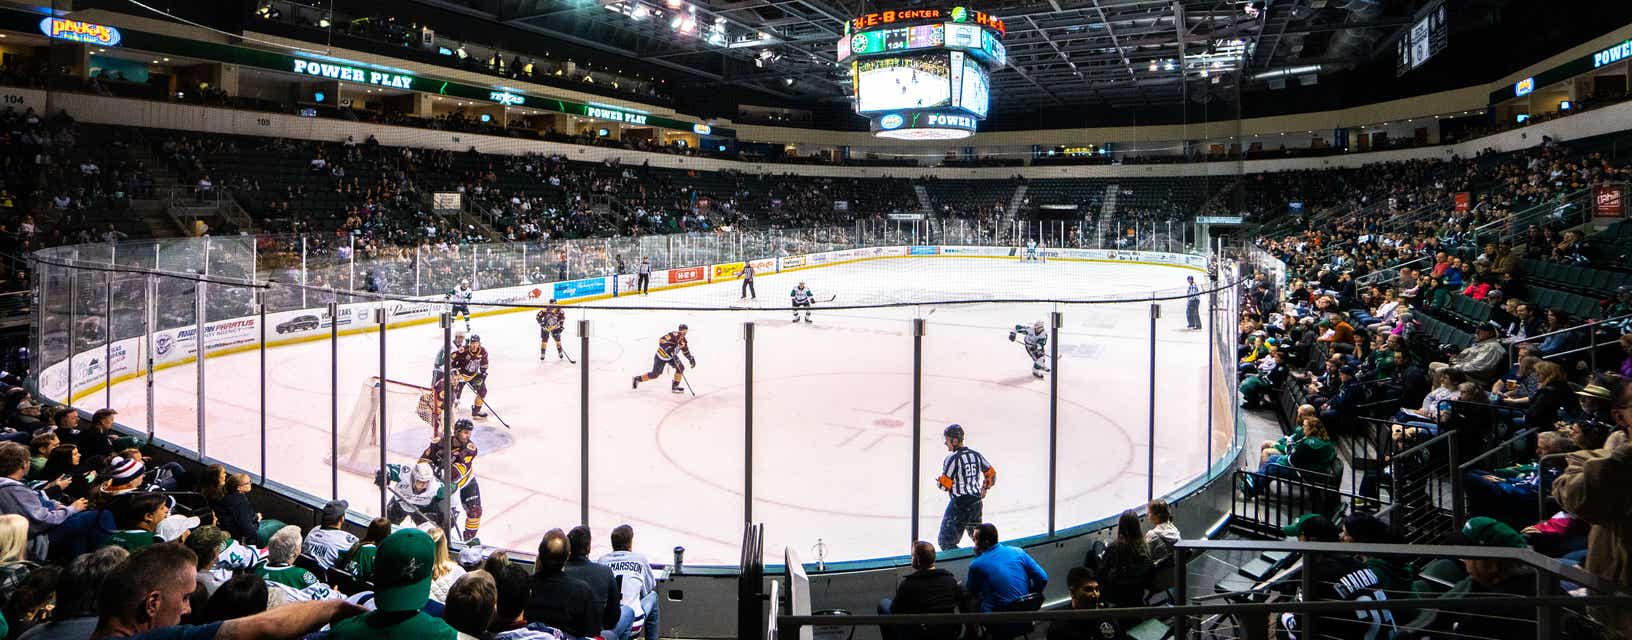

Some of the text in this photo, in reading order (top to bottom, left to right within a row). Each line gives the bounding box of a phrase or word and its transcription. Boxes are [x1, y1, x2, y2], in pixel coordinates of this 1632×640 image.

[898, 10, 939, 19] CENTER
[293, 59, 413, 89] POWER PLAY
[489, 91, 526, 106] TEXAS
[588, 107, 647, 125] POWER PLAY
[928, 114, 970, 127] POWER
[965, 463, 977, 477] 26
